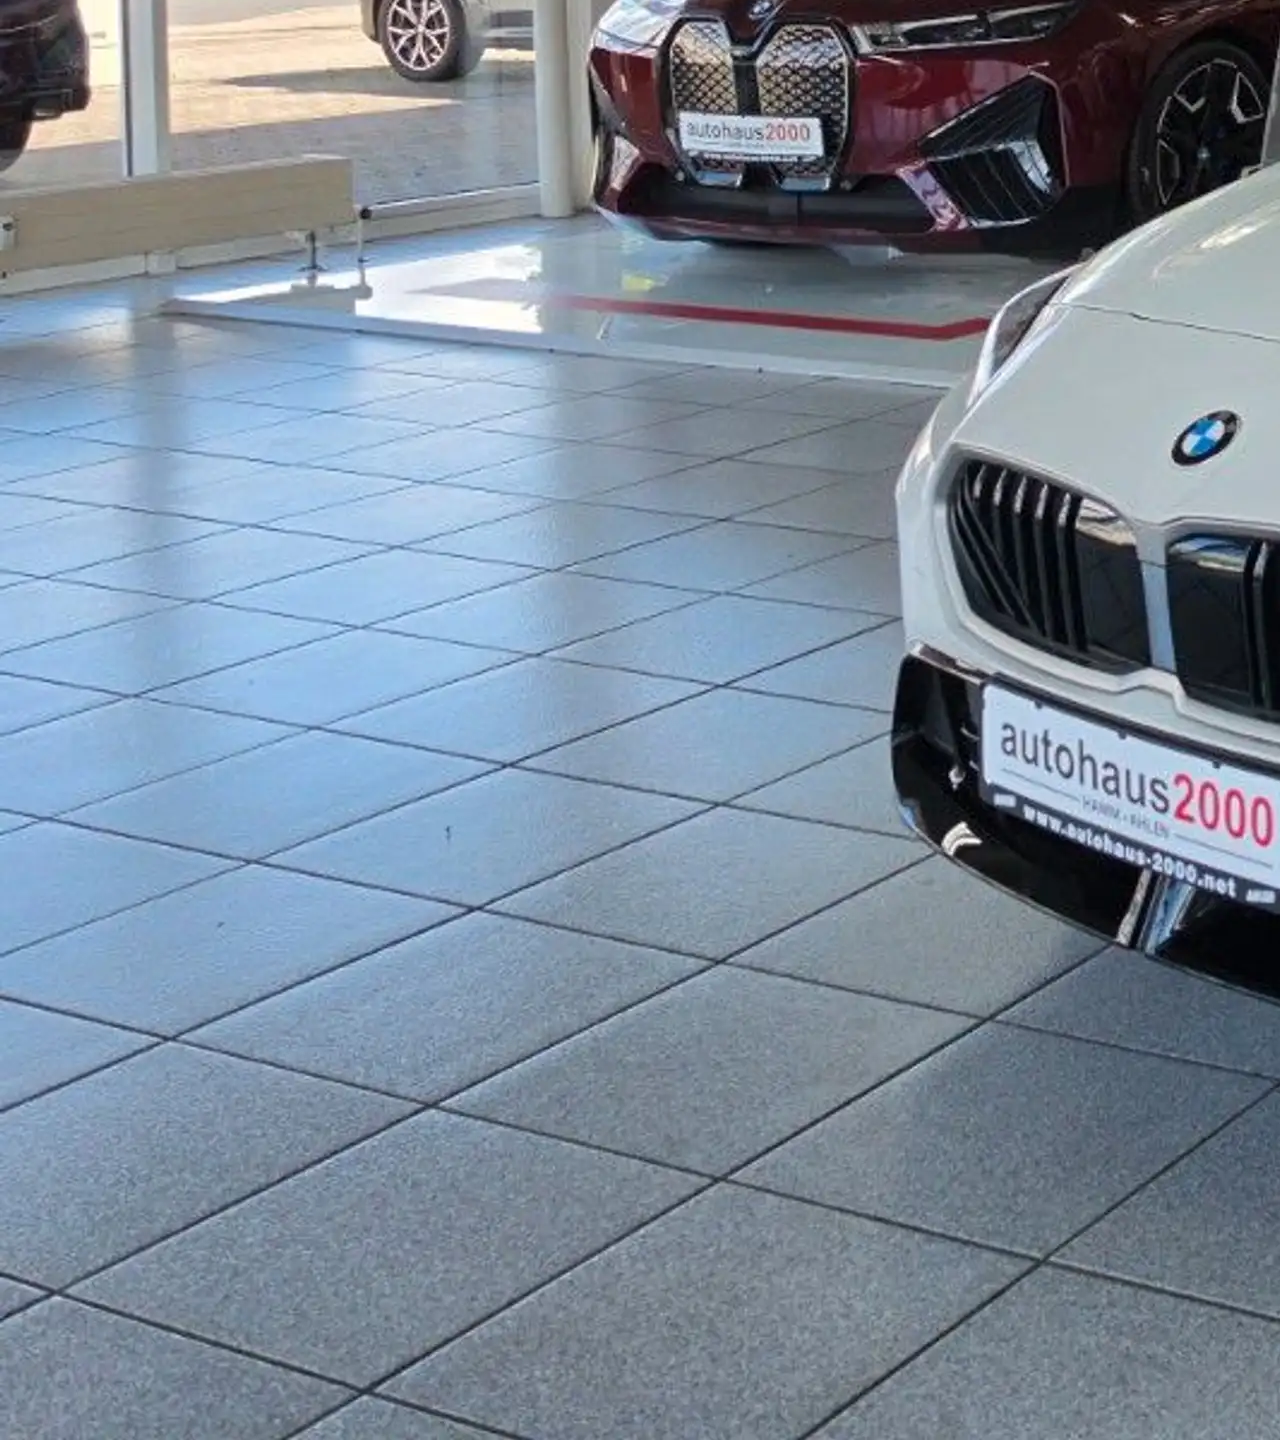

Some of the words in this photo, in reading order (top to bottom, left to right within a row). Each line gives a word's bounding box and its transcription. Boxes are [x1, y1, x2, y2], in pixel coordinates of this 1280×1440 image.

[687, 121, 811, 142] autohaus2000
[1000, 721, 1274, 848] autohaus2000
[1022, 803, 1238, 898] www.autohaus-2000.net
